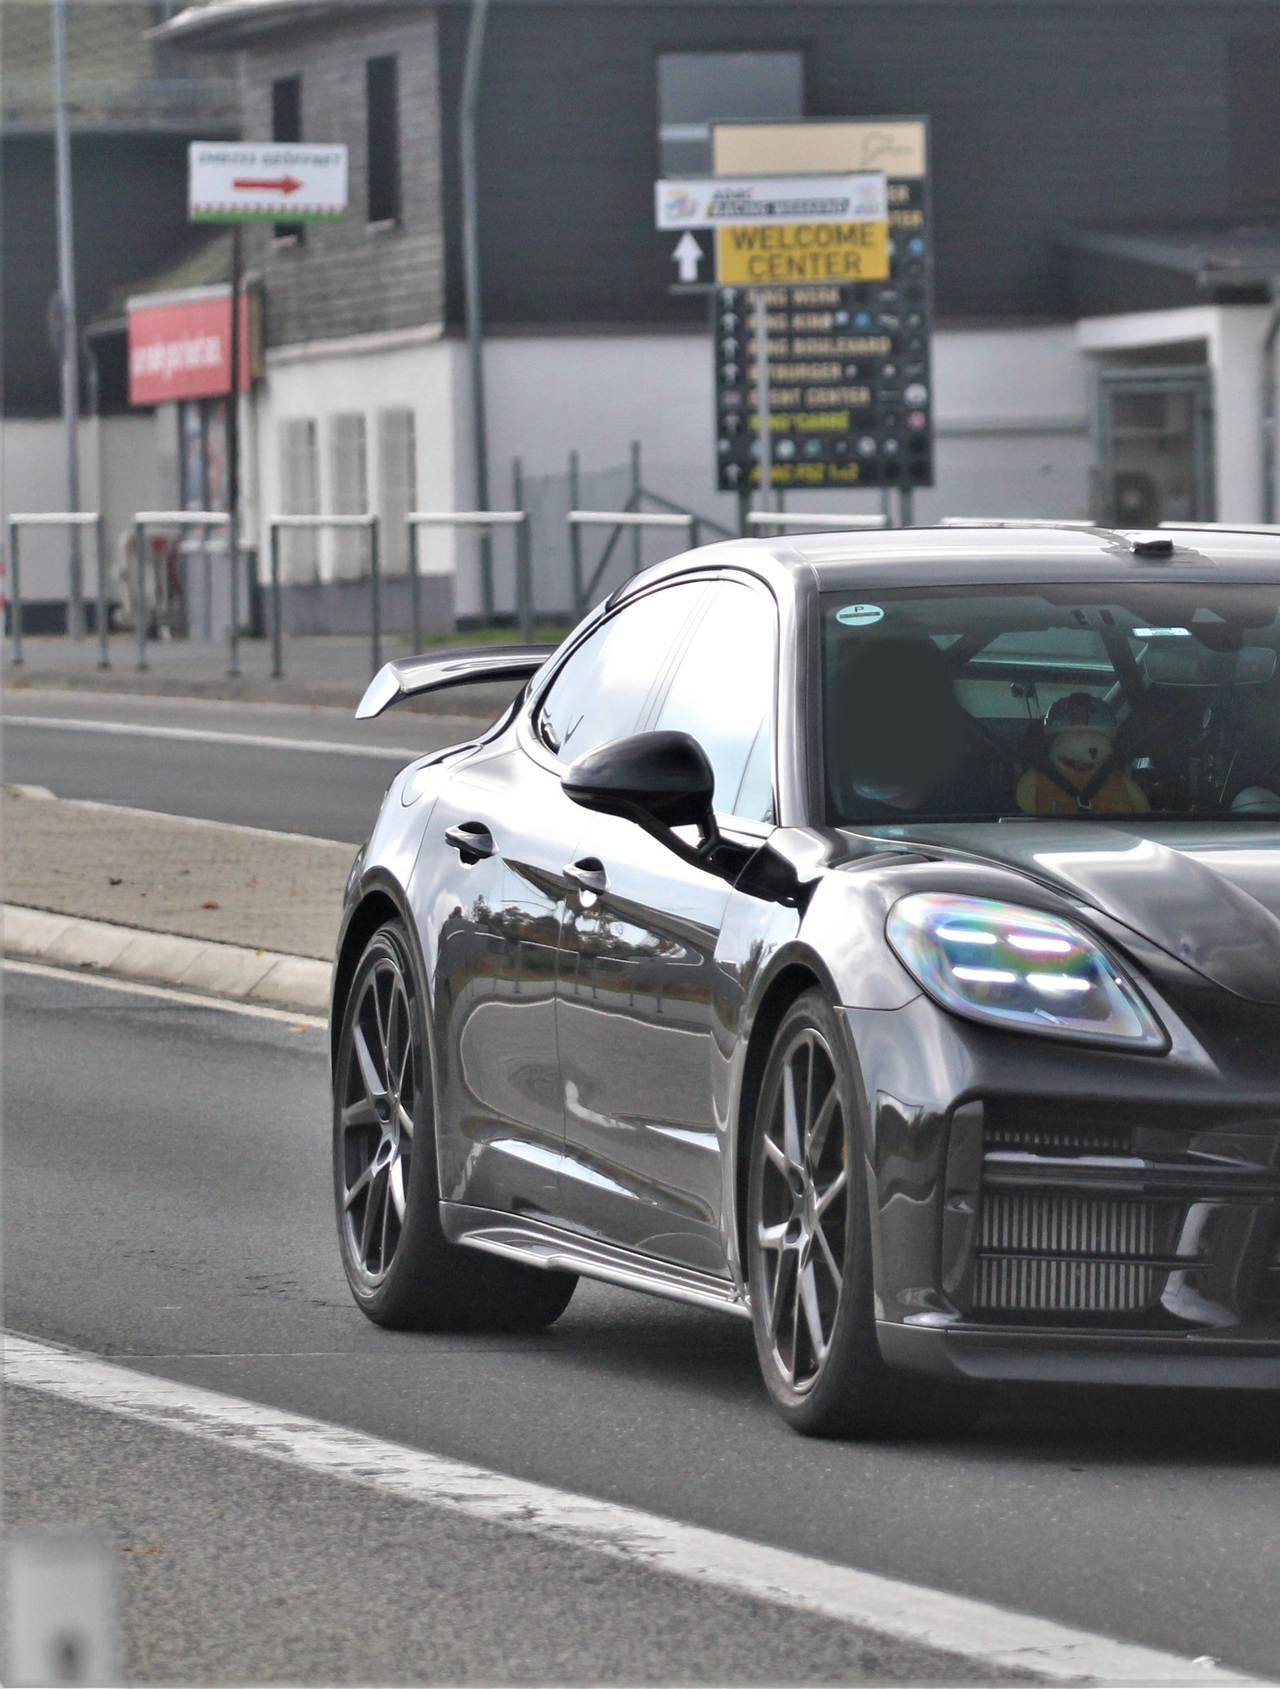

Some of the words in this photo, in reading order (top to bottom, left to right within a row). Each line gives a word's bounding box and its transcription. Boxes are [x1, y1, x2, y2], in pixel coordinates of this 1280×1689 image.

[731, 222, 876, 250] WELCOME
[749, 252, 862, 278] CENTER
[746, 312, 788, 330] RNG
[746, 338, 789, 355] RNG
[747, 362, 842, 381] BTBURGER
[748, 388, 801, 406] EENT
